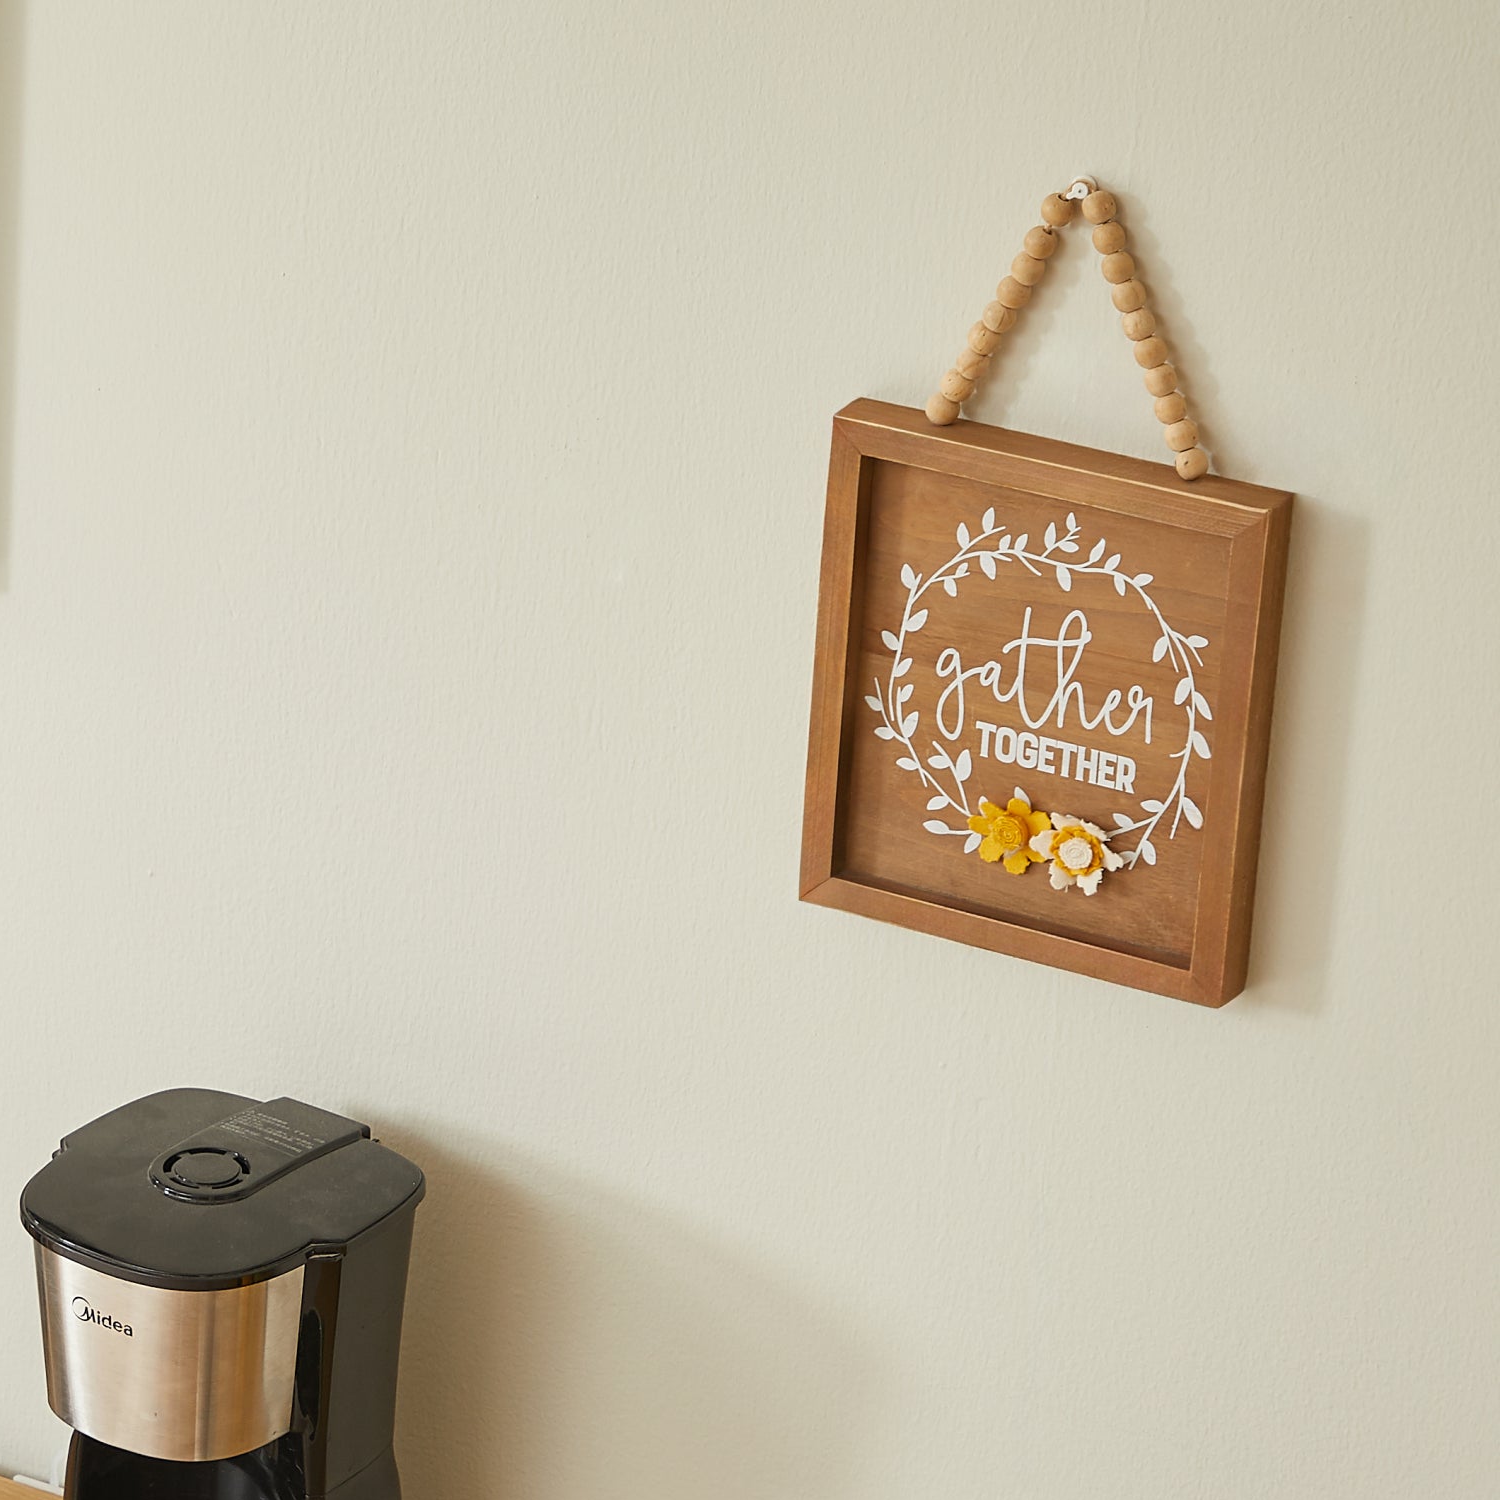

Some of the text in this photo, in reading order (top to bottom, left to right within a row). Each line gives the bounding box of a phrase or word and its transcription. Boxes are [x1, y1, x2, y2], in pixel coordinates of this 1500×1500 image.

[935, 606, 1154, 745] gather
[975, 720, 1137, 795] TOGETHER
[71, 1296, 133, 1337] Midea
